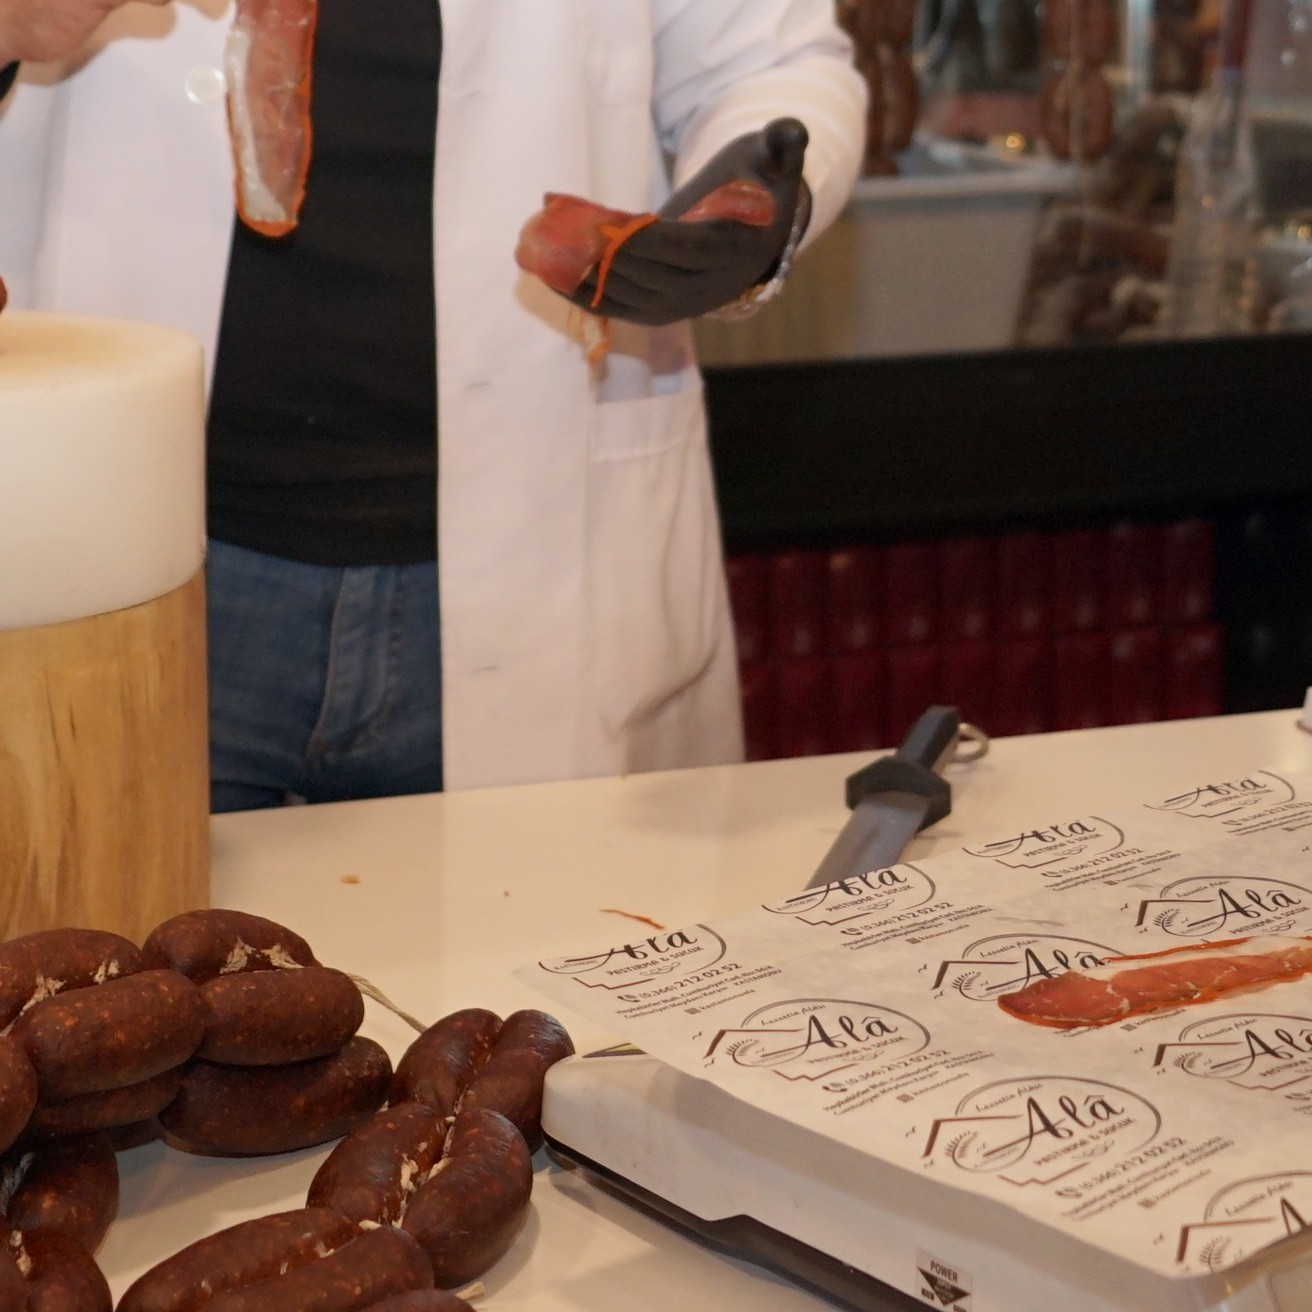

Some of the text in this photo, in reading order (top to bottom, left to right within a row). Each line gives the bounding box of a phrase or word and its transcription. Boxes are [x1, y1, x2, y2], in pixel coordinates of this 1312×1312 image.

[1187, 887, 1302, 928] Alâ
[675, 973, 704, 990] 212
[701, 966, 722, 982] 02
[721, 961, 743, 976] 52
[760, 1013, 898, 1059] Alâ
[982, 1094, 1126, 1158] Alâ
[930, 1259, 958, 1284] POWER
